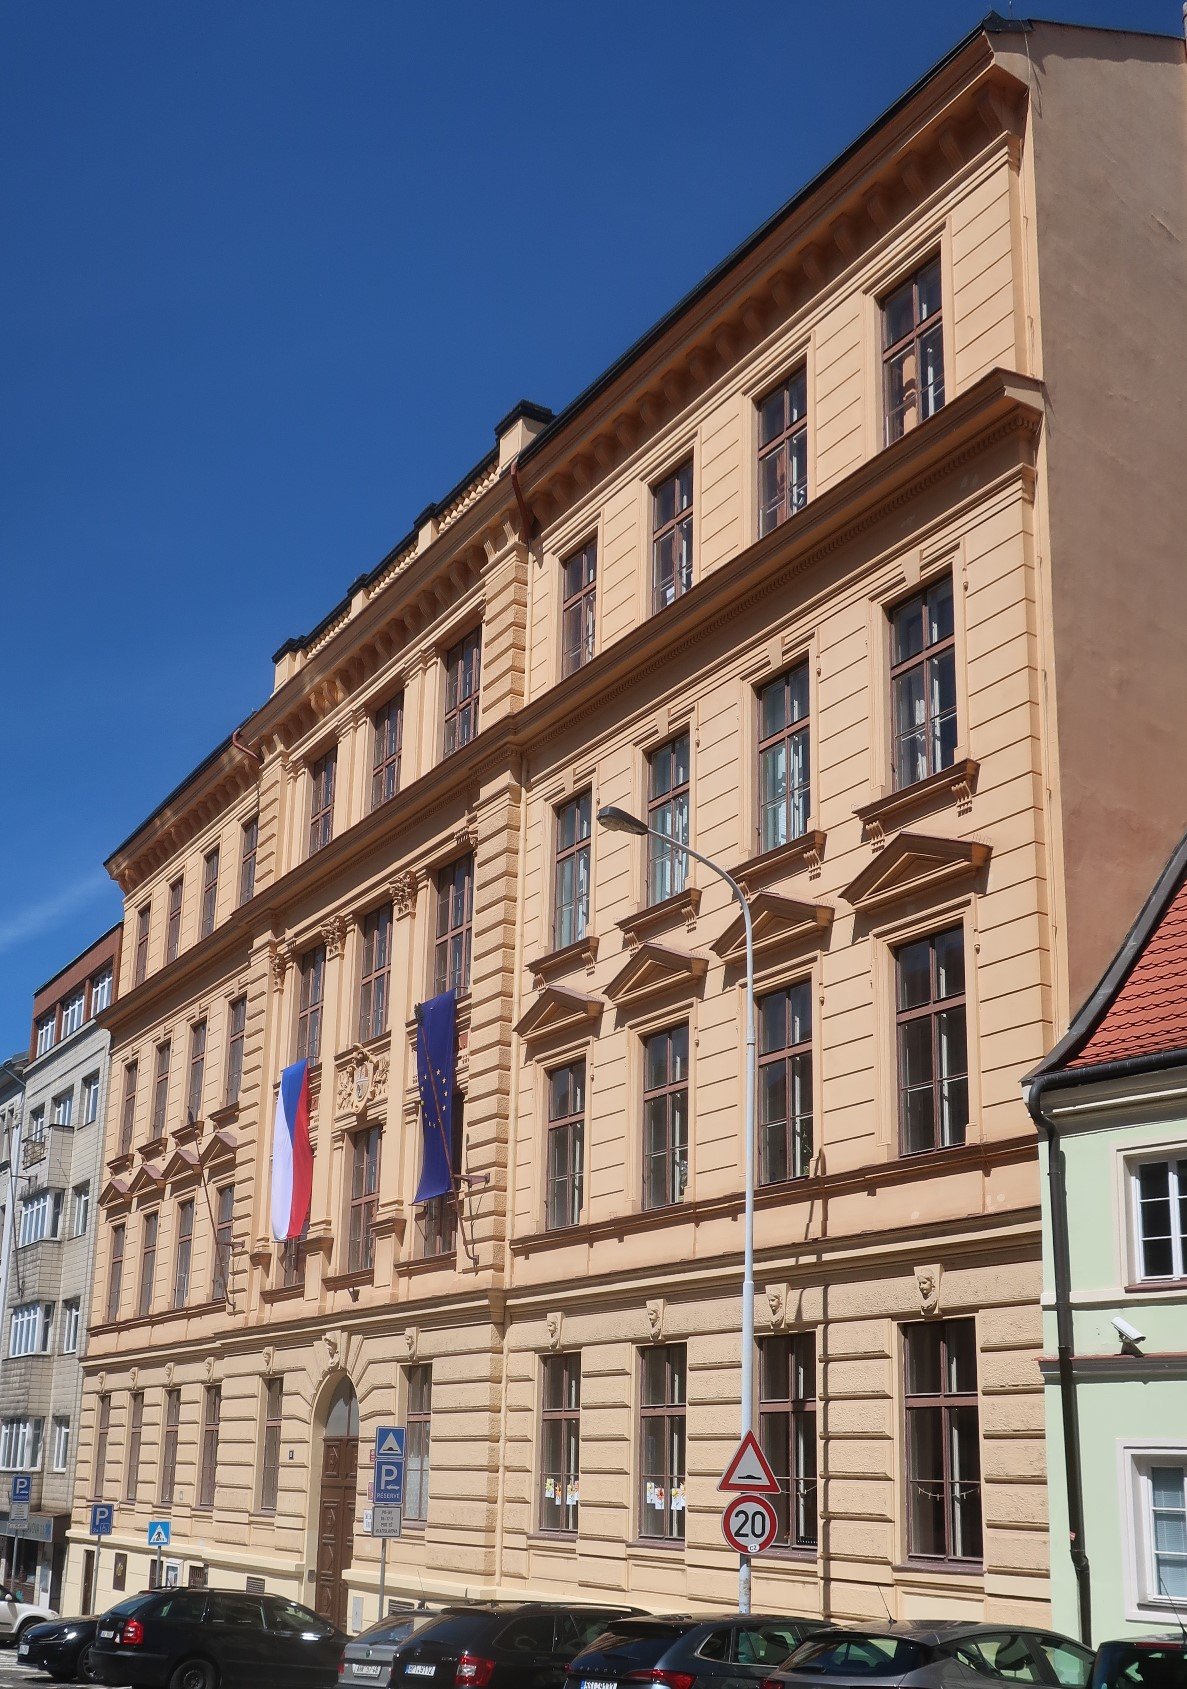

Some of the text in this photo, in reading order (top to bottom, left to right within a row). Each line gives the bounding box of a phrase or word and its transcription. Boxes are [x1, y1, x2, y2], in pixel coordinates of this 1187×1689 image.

[16, 1479, 27, 1494] P
[381, 1465, 397, 1489] P
[96, 1508, 108, 1525] P
[734, 1510, 765, 1538] 20
